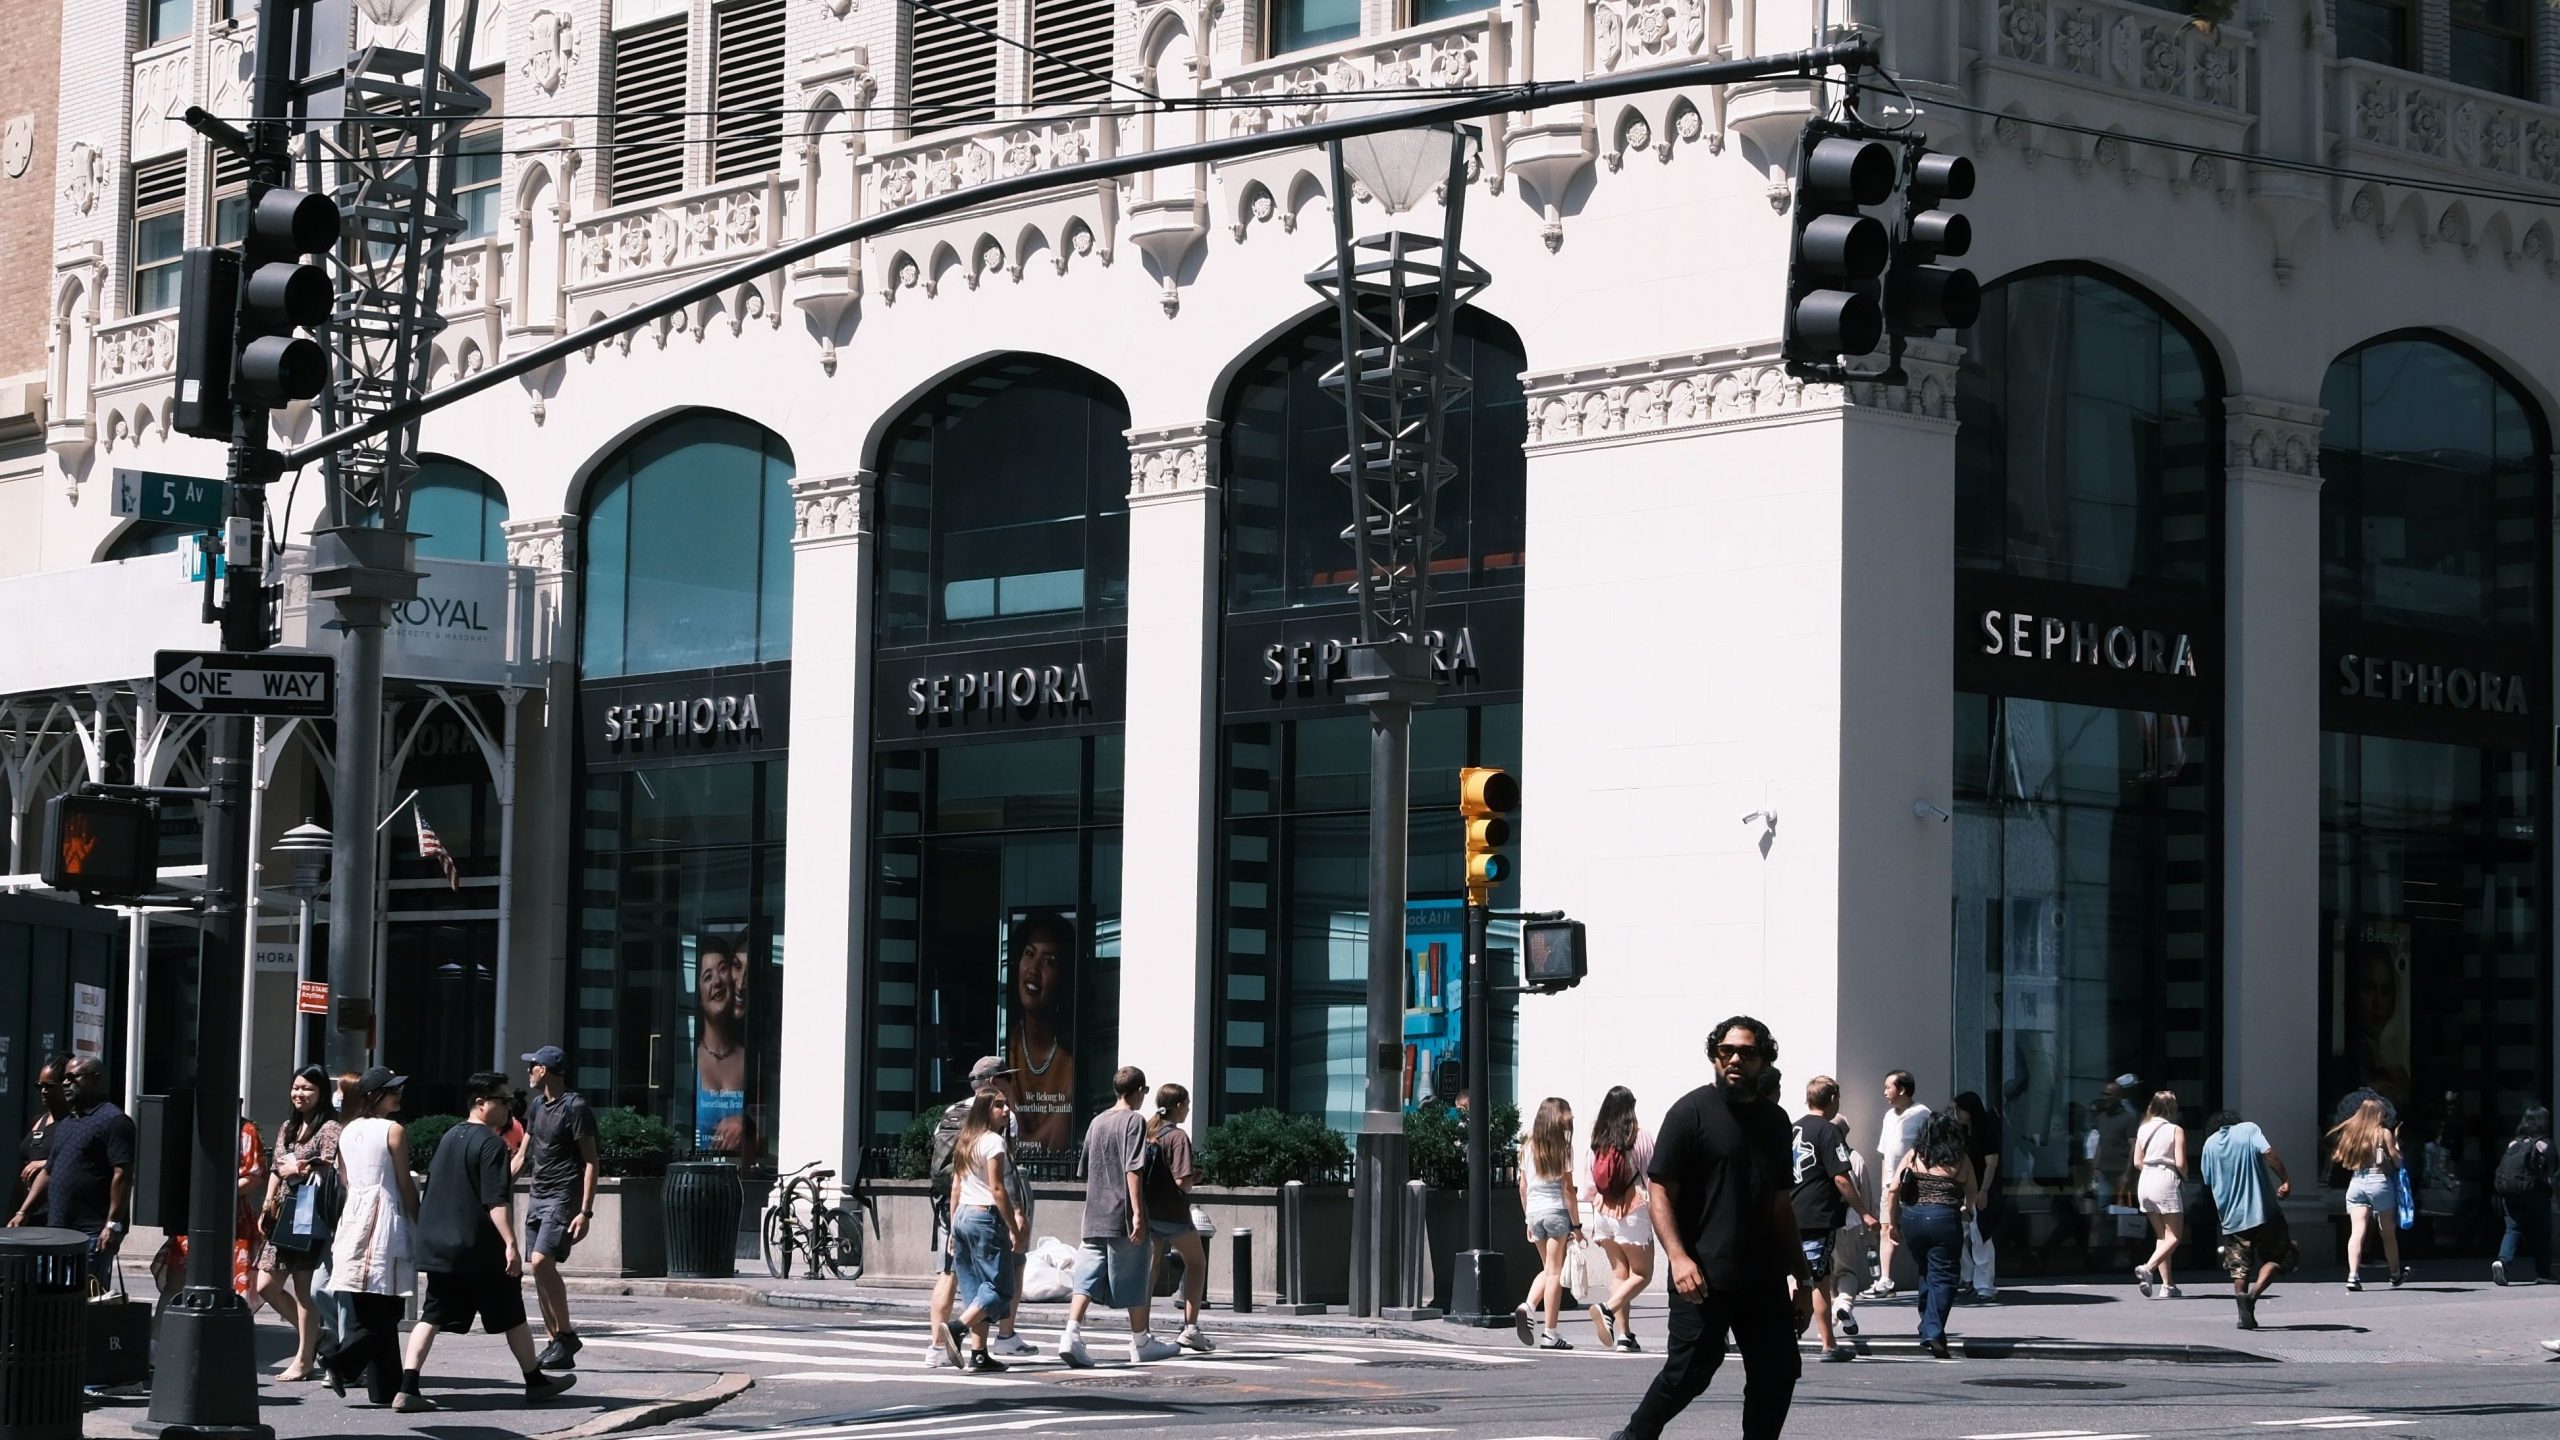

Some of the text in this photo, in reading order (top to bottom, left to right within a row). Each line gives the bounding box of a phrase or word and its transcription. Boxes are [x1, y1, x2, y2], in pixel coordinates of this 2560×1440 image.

[161, 481, 204, 516] 5 Av
[1261, 627, 1476, 686] SEPRA
[1981, 610, 2197, 678] SEPHORA
[180, 671, 318, 697] ONE WAY
[907, 663, 1090, 717] SEPHORA
[2339, 653, 2528, 716] SEPHORA
[604, 693, 761, 742] SEPHORA
[1408, 910, 1427, 926] ack
[257, 952, 294, 963] HORA
[1015, 1102, 1047, 1114] Something
[1025, 1091, 1065, 1103] We Belong to
